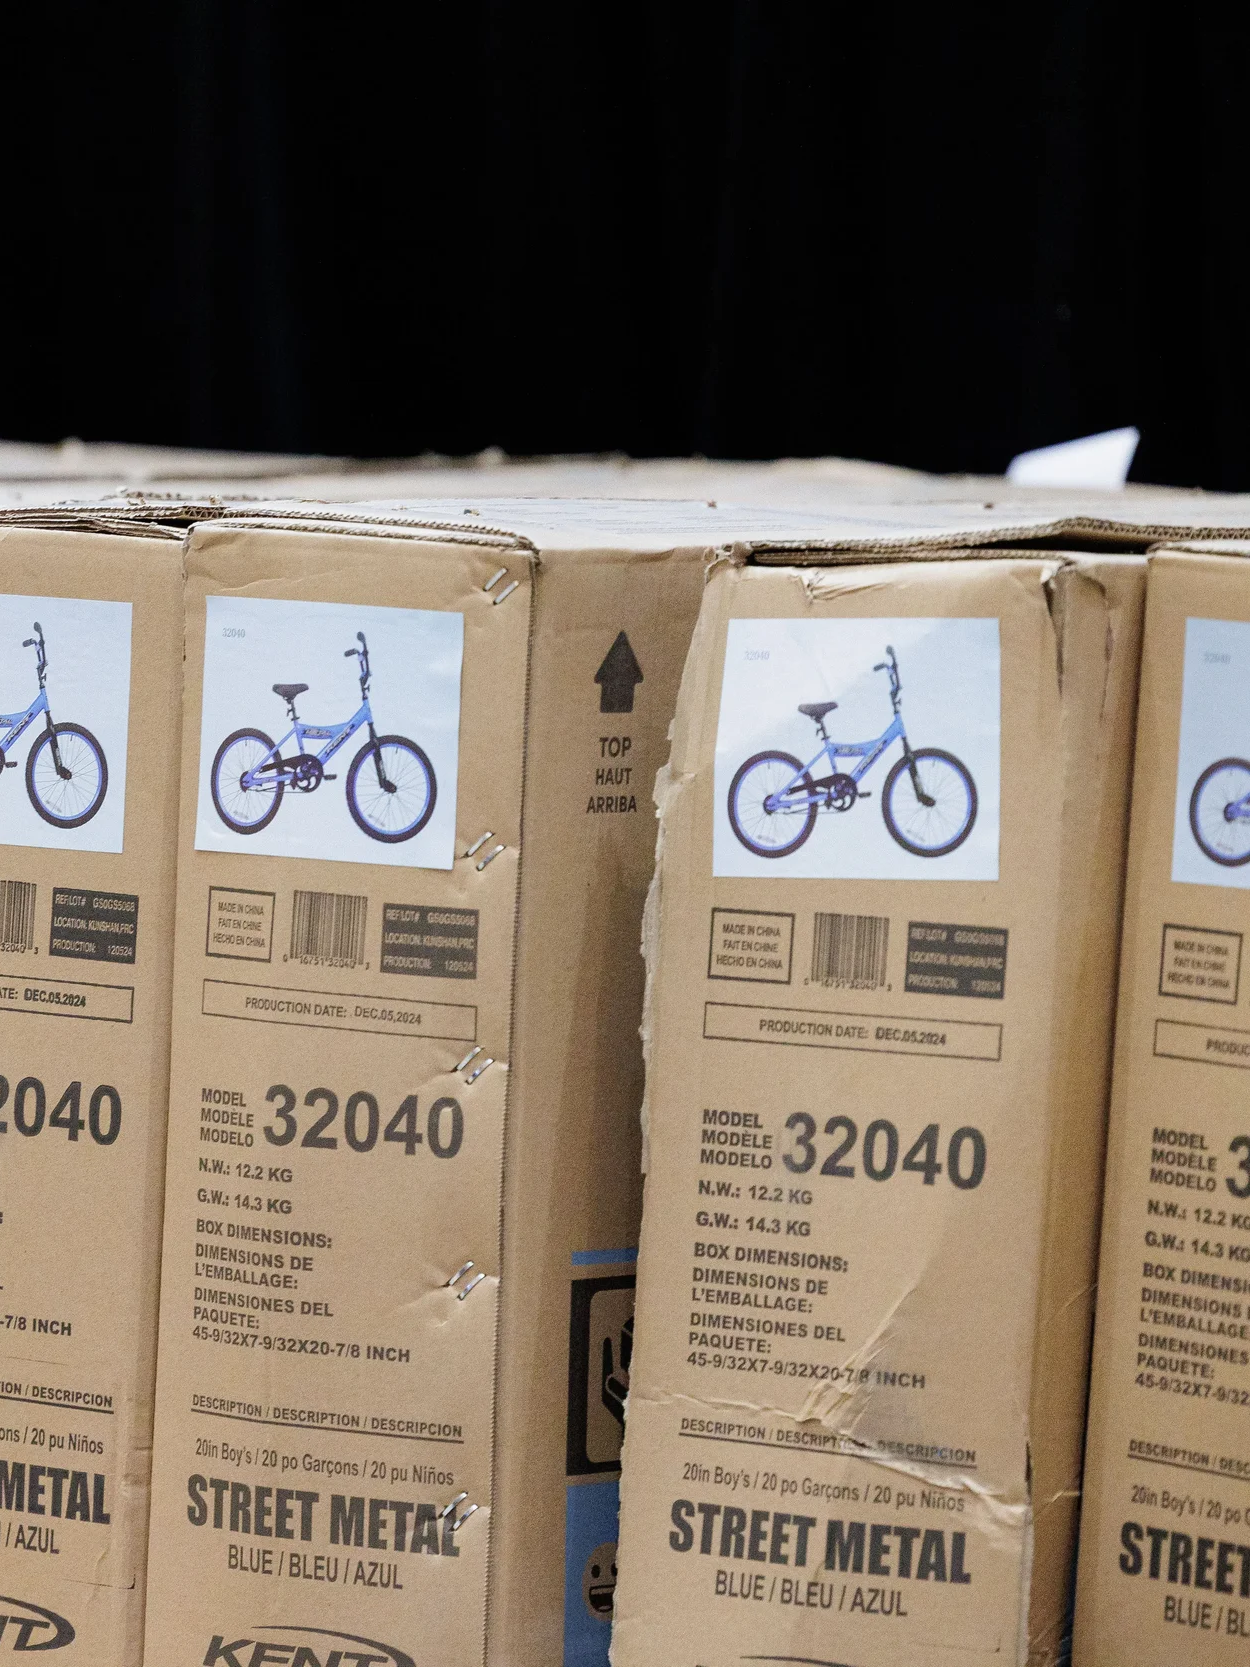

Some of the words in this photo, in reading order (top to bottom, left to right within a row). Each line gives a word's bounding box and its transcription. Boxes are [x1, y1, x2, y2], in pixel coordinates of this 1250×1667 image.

[222, 628, 246, 638] 32040
[599, 737, 631, 758] TOP
[595, 768, 632, 785] HAUT
[586, 796, 637, 813] ARRIBA
[54, 917, 87, 931] LOCATION:
[52, 939, 96, 954] PRODUCTION:
[245, 996, 311, 1014] PRODUCTION
[314, 1004, 347, 1018] DATE:
[202, 1088, 246, 1107] MODEL
[201, 1108, 254, 1128] MODÈLE
[263, 1084, 464, 1159] 32040
[703, 1109, 763, 1129] MODEL
[200, 1127, 254, 1147] MODELO
[701, 1129, 773, 1150] MODÈLE
[1152, 1127, 1208, 1150] MODEL
[700, 1149, 772, 1170] MODELO
[782, 1112, 987, 1190] 32040
[199, 1157, 230, 1176] N.W.:
[236, 1162, 263, 1180] 12.2
[268, 1168, 292, 1182] KG
[1150, 1168, 1216, 1192] MODELO
[197, 1188, 229, 1206] G.W.:
[234, 1194, 262, 1212] 14.3
[267, 1199, 292, 1214] KG
[748, 1185, 783, 1202] 12.2
[788, 1189, 813, 1205] KG
[196, 1218, 223, 1236] BOX
[227, 1225, 332, 1248] DIMENSIONS:
[746, 1216, 780, 1234] 14.3
[786, 1221, 810, 1237] KG
[196, 1243, 284, 1269] DIMENSIONS
[290, 1256, 313, 1271] DE
[194, 1262, 298, 1289] L'EMBALLAGE:
[194, 1287, 294, 1313] DIMENSIONES
[301, 1302, 334, 1317] DEL
[32, 1318, 72, 1336] INCH
[194, 1306, 260, 1329] PAQUETE:
[193, 1326, 360, 1358] 45-9/32X7-9/32X20-7/8
[366, 1346, 410, 1363] INCH
[689, 1332, 771, 1354] PAQUETE:
[1137, 1352, 1215, 1379] PAQUETE:
[32, 1385, 113, 1408] DESCRIPCION
[192, 1394, 262, 1417] DESCRIPTION
[273, 1407, 360, 1428] DESCRIPTION
[371, 1417, 462, 1437] DESCRIPCION
[31, 1428, 45, 1446] 20
[50, 1434, 64, 1452] pu
[69, 1433, 104, 1454] Niños
[195, 1438, 218, 1459] 20in
[221, 1442, 252, 1467] Boy's
[262, 1449, 277, 1468] 20
[282, 1456, 298, 1473] po
[302, 1454, 359, 1478] Garçons
[371, 1460, 387, 1479] 20
[391, 1466, 407, 1485] pu
[413, 1464, 454, 1486] Niños
[187, 1474, 319, 1542] STREET
[329, 1494, 460, 1557] METAL
[14, 1526, 59, 1555] AZUL
[669, 1499, 816, 1568] STREET
[825, 1519, 971, 1585] METAL
[228, 1544, 273, 1576] BLUE
[288, 1553, 338, 1583] BLEU
[353, 1560, 403, 1589] AZUL
[1119, 1521, 1250, 1599] STREET
[715, 1569, 765, 1601] BLUE
[781, 1579, 834, 1609] BLEU
[850, 1587, 908, 1617] AZUL
[1164, 1595, 1213, 1630] BLUE
